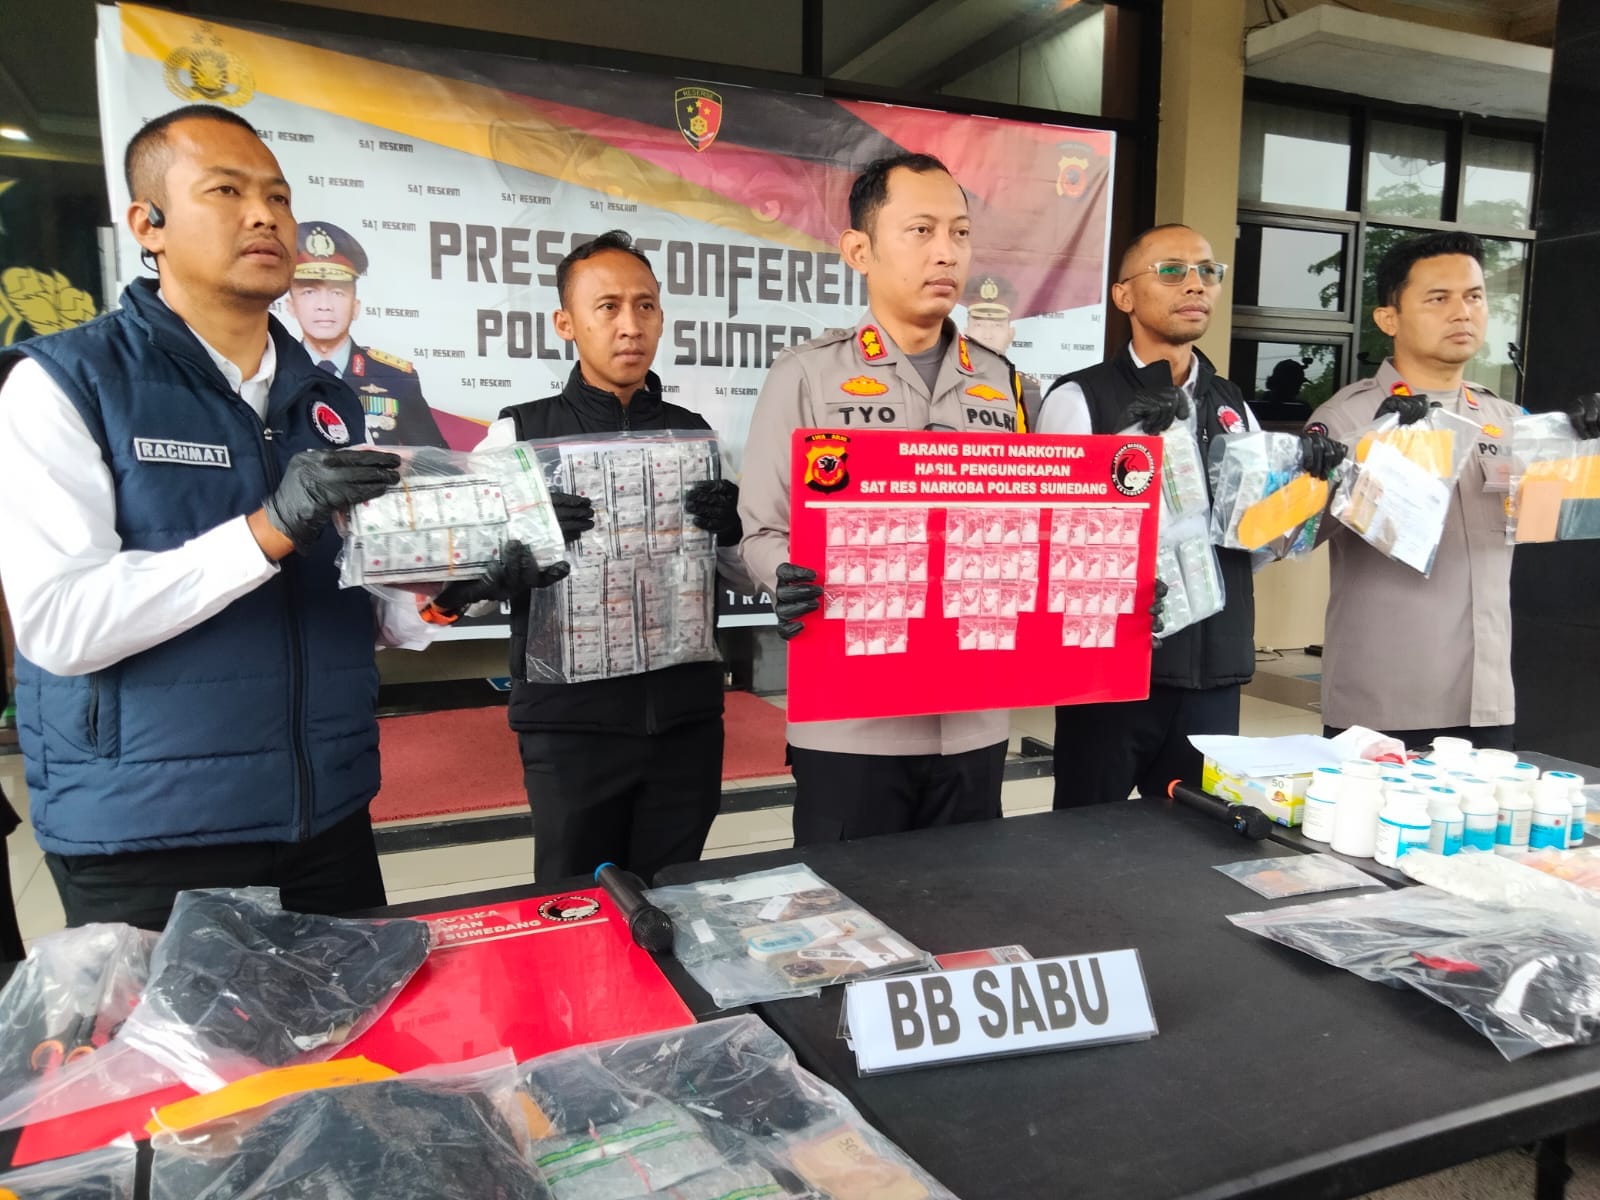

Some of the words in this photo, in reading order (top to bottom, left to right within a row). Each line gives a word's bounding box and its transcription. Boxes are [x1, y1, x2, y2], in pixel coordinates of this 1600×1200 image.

[257, 129, 273, 141] SAT
[278, 131, 315, 143] RESKRIM
[359, 139, 375, 151] SAT
[379, 141, 414, 153] RESKRIM
[308, 176, 324, 187] SAT
[328, 177, 364, 189] RESKRIM
[407, 184, 422, 196] SAT
[427, 185, 460, 197] RESKRIM
[501, 193, 516, 205] SAT
[520, 194, 551, 205] RESKRIM
[590, 201, 604, 212] SAT
[362, 219, 378, 231] SAT
[382, 221, 416, 232] RESKRIM
[365, 307, 381, 318] SAT
[385, 307, 420, 318] RESKRIM
[413, 348, 428, 359] SAT
[432, 348, 466, 359] RESKRIM
[461, 378, 476, 389] SAT
[479, 378, 512, 388] RESKRIM
[715, 386, 728, 397] SAT
[731, 387, 758, 396] RESKRIM
[838, 406, 896, 425] TYO
[966, 408, 1015, 432] POLRI
[141, 442, 225, 463] RACHMAT
[899, 443, 959, 457] BARANG
[962, 444, 1005, 457] BUKTI
[1008, 445, 1085, 459] NARKOTIKA
[914, 462, 957, 476] HASIL
[960, 463, 1071, 477] PENGUNGKAPAN
[860, 481, 887, 494] SAT
[890, 481, 917, 494] RES
[920, 481, 985, 494] NARKOBA
[988, 482, 1037, 495] POLRES
[1040, 482, 1108, 495] SUMEDANG
[1271, 778, 1285, 789] 50
[445, 919, 542, 941] SUMEDANG
[885, 975, 961, 1051] BB
[972, 957, 1110, 1039] SABU
